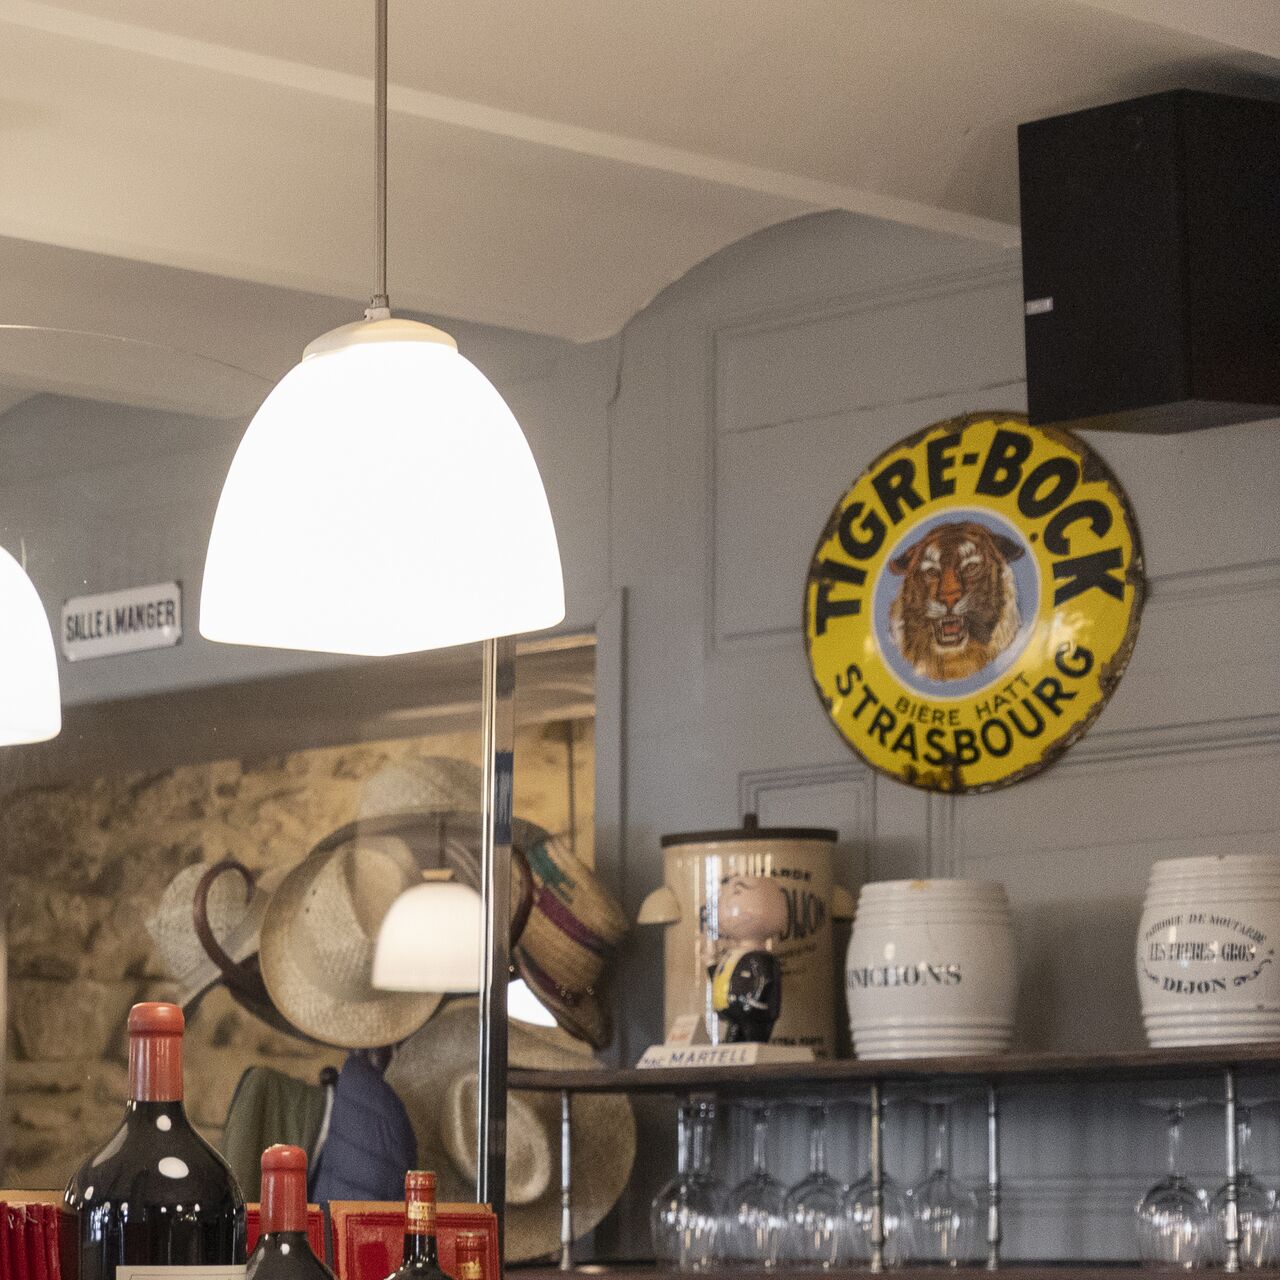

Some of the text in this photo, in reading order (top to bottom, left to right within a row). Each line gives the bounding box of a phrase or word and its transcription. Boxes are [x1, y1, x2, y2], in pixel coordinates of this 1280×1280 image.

[815, 428, 1126, 637] TIGRE-BOCK
[66, 609, 103, 642] SALLE
[115, 599, 175, 634] MANGER
[835, 641, 1095, 767] STRASBOURG
[894, 671, 1032, 727] BIÈRE HATT
[1162, 977, 1227, 995] DIJON
[670, 1049, 749, 1063] MARTELL
